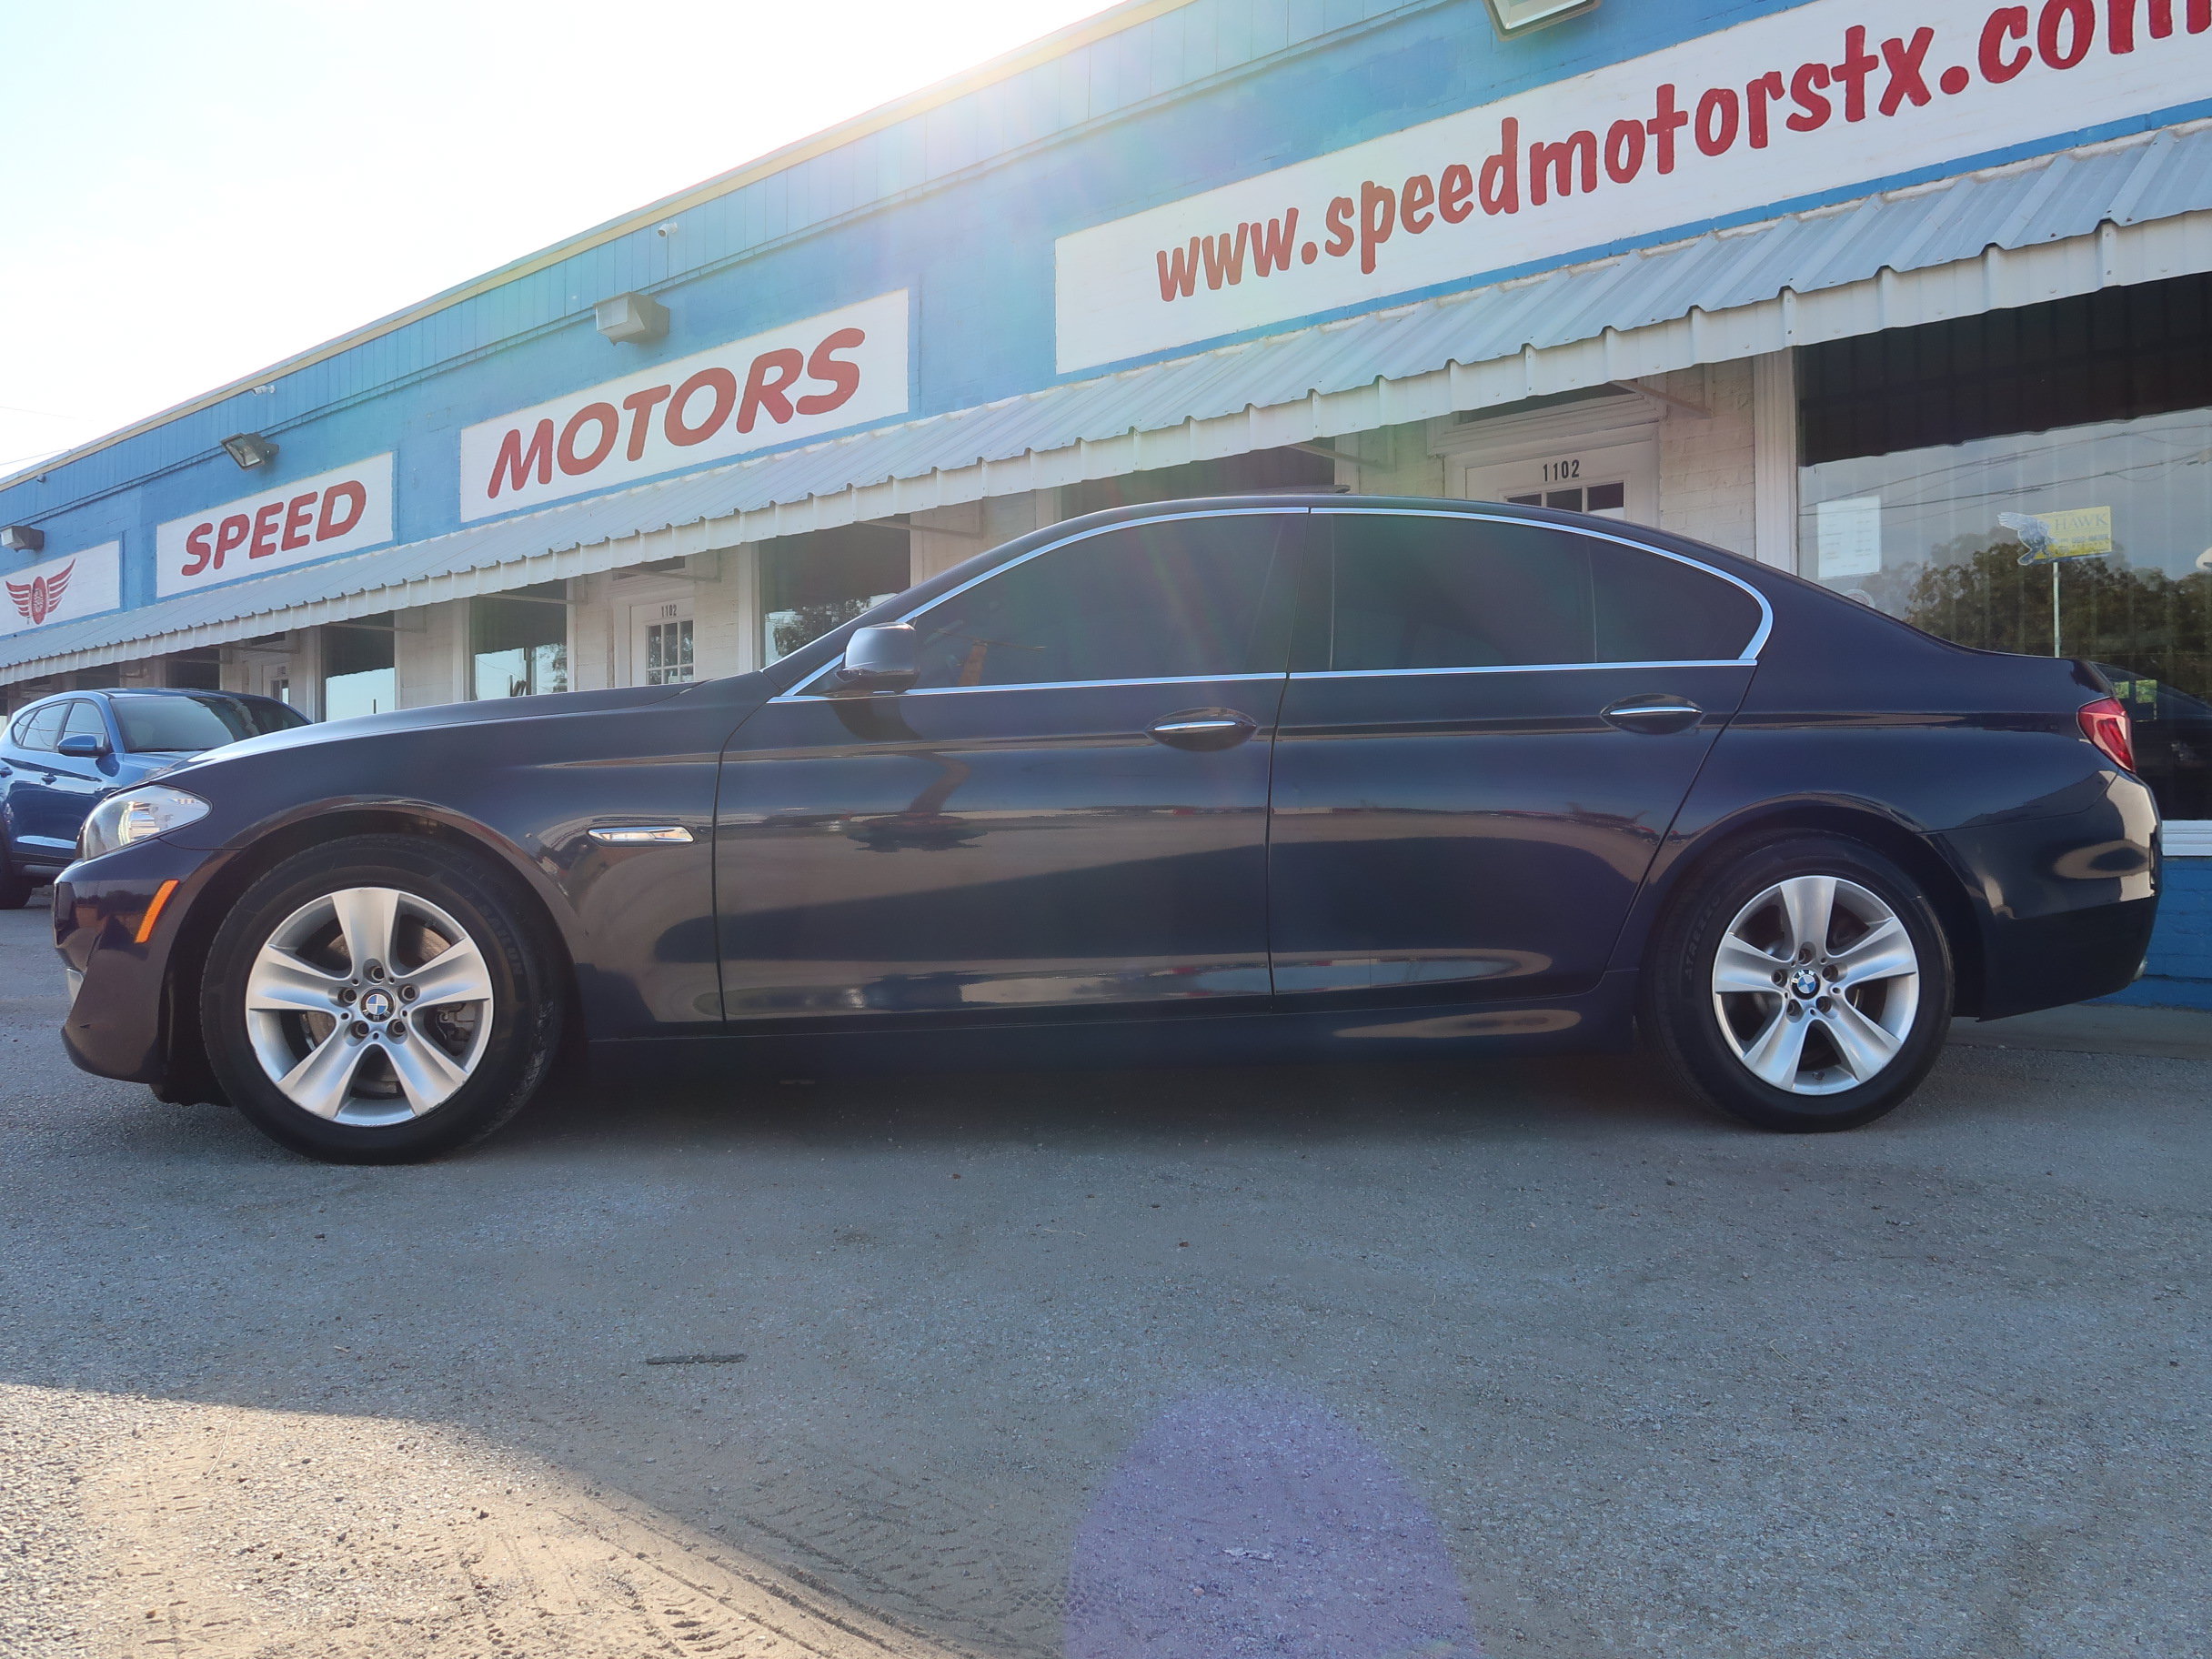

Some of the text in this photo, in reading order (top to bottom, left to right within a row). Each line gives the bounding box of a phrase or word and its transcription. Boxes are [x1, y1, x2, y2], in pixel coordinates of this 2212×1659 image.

[182, 327, 864, 576] SPEED MOTORS
[1543, 459, 1580, 482] 1102
[661, 604, 678, 618] 1102
